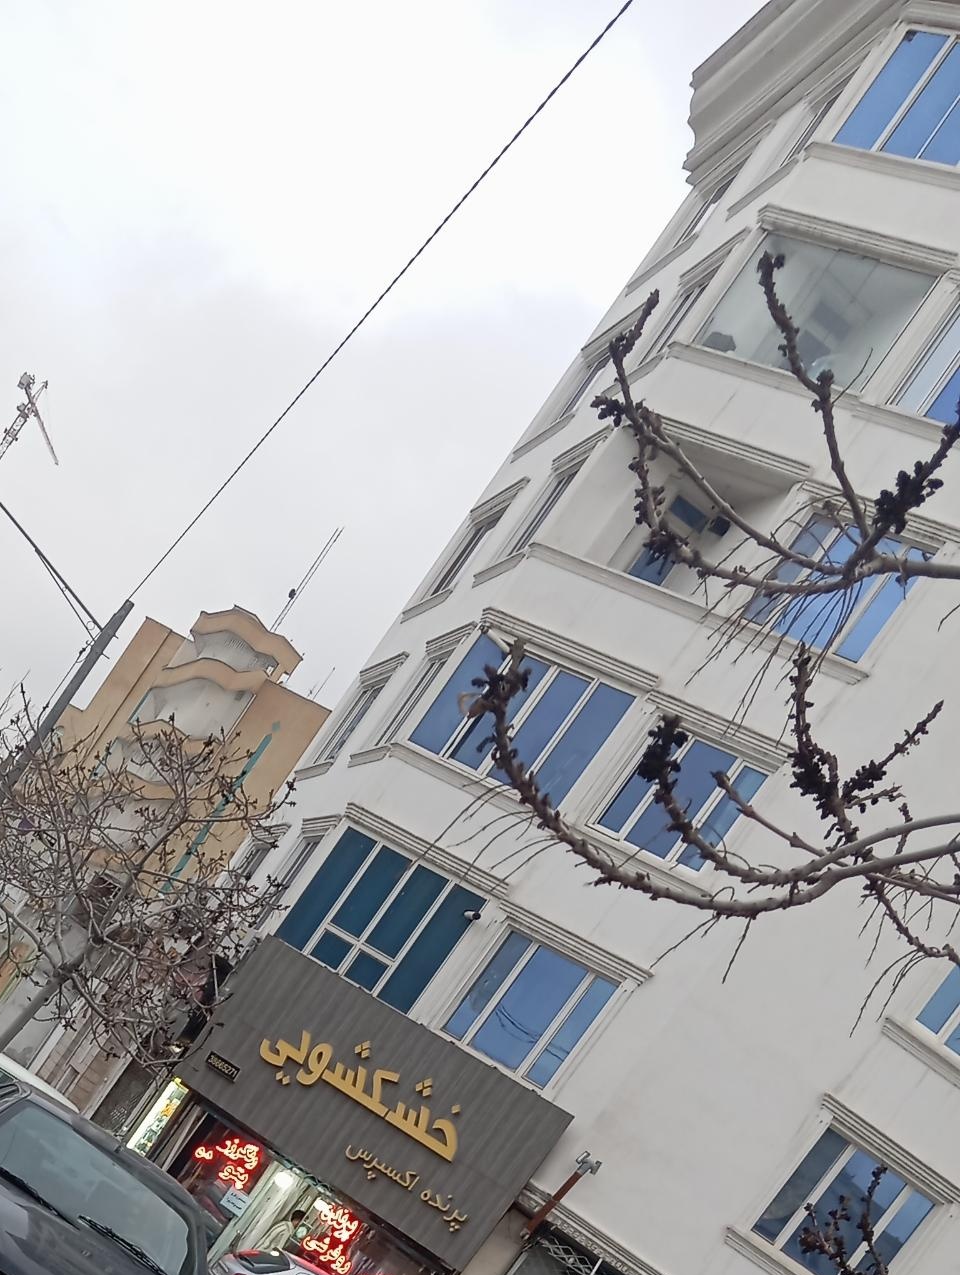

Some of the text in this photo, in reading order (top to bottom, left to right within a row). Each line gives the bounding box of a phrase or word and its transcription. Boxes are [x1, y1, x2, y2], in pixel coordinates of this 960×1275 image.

[258, 1030, 460, 1162] خشکشویی
[344, 1143, 468, 1232] پرنده اکسپرس
[302, 1235, 352, 1275] روفرشی
